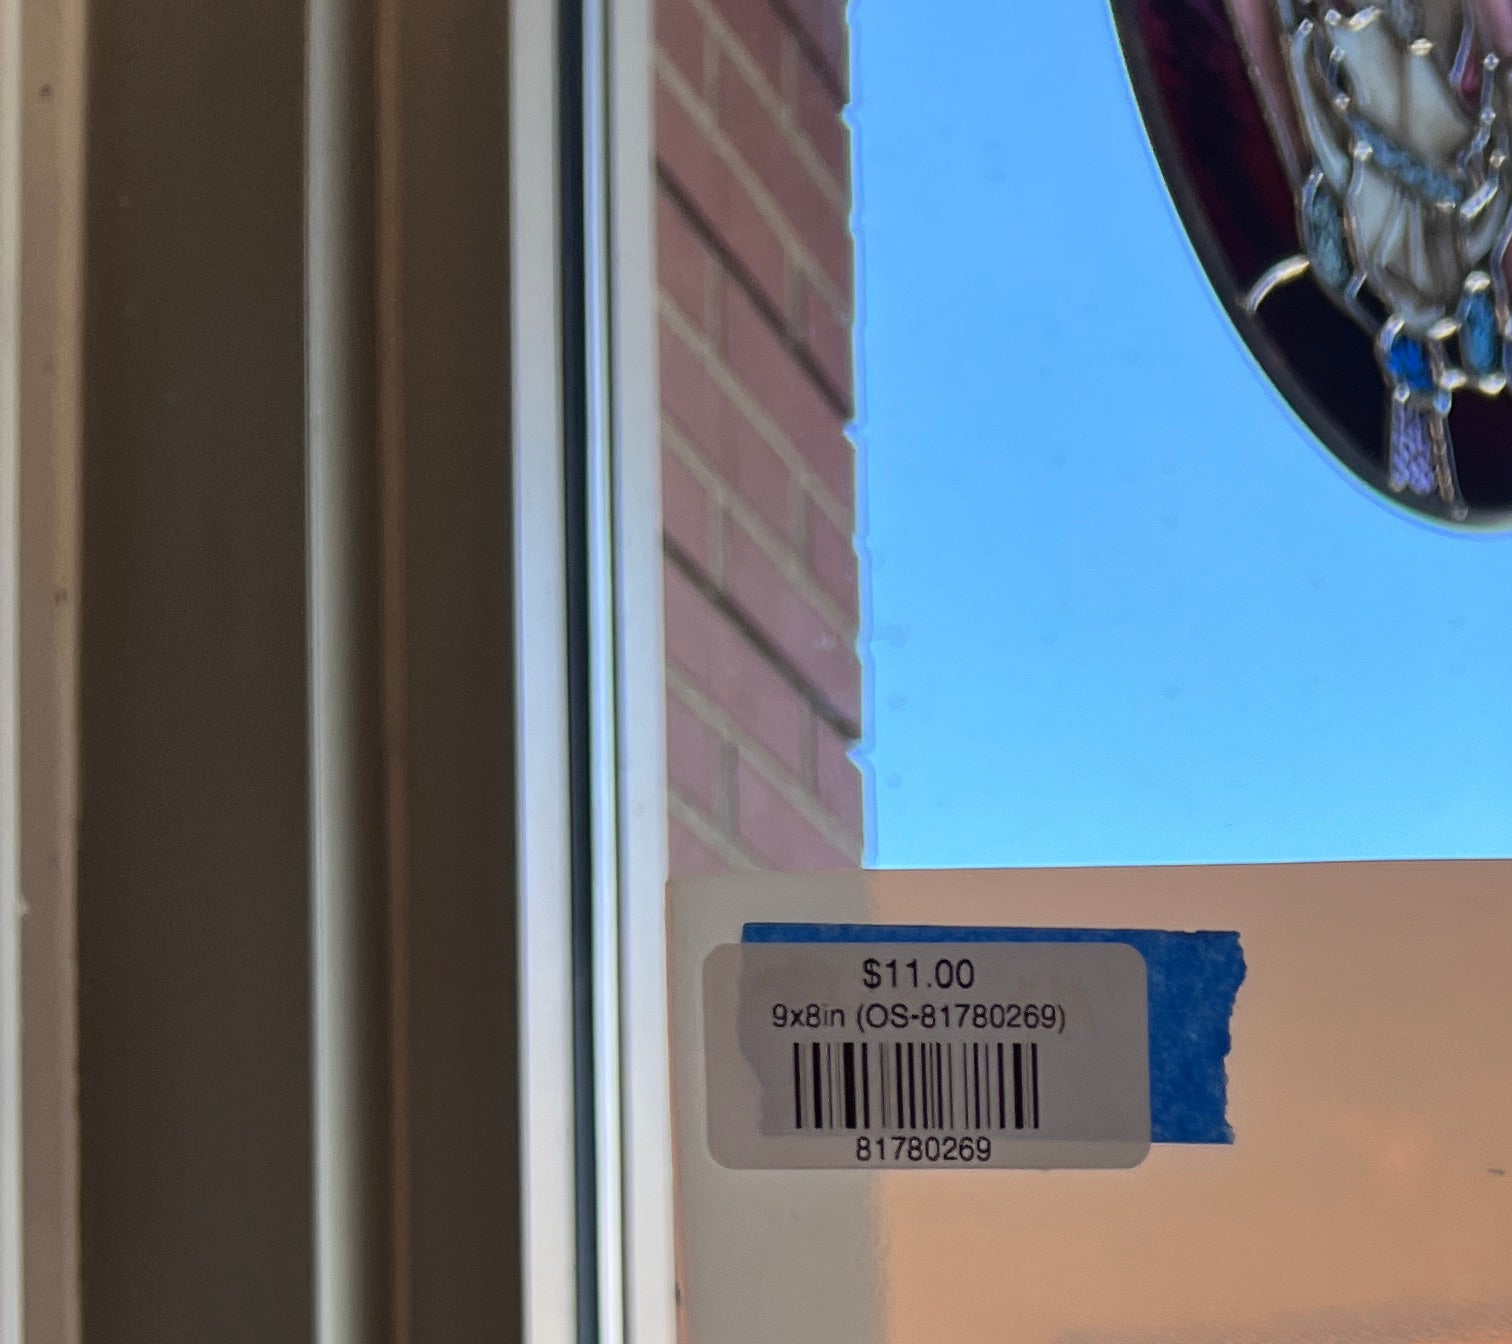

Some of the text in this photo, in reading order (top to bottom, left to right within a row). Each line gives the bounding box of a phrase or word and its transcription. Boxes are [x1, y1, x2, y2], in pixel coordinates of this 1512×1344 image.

[862, 959, 975, 989] $11.00
[771, 1003, 1066, 1033] 9x8in (OS-81780269)
[856, 1136, 992, 1162] 81780269
